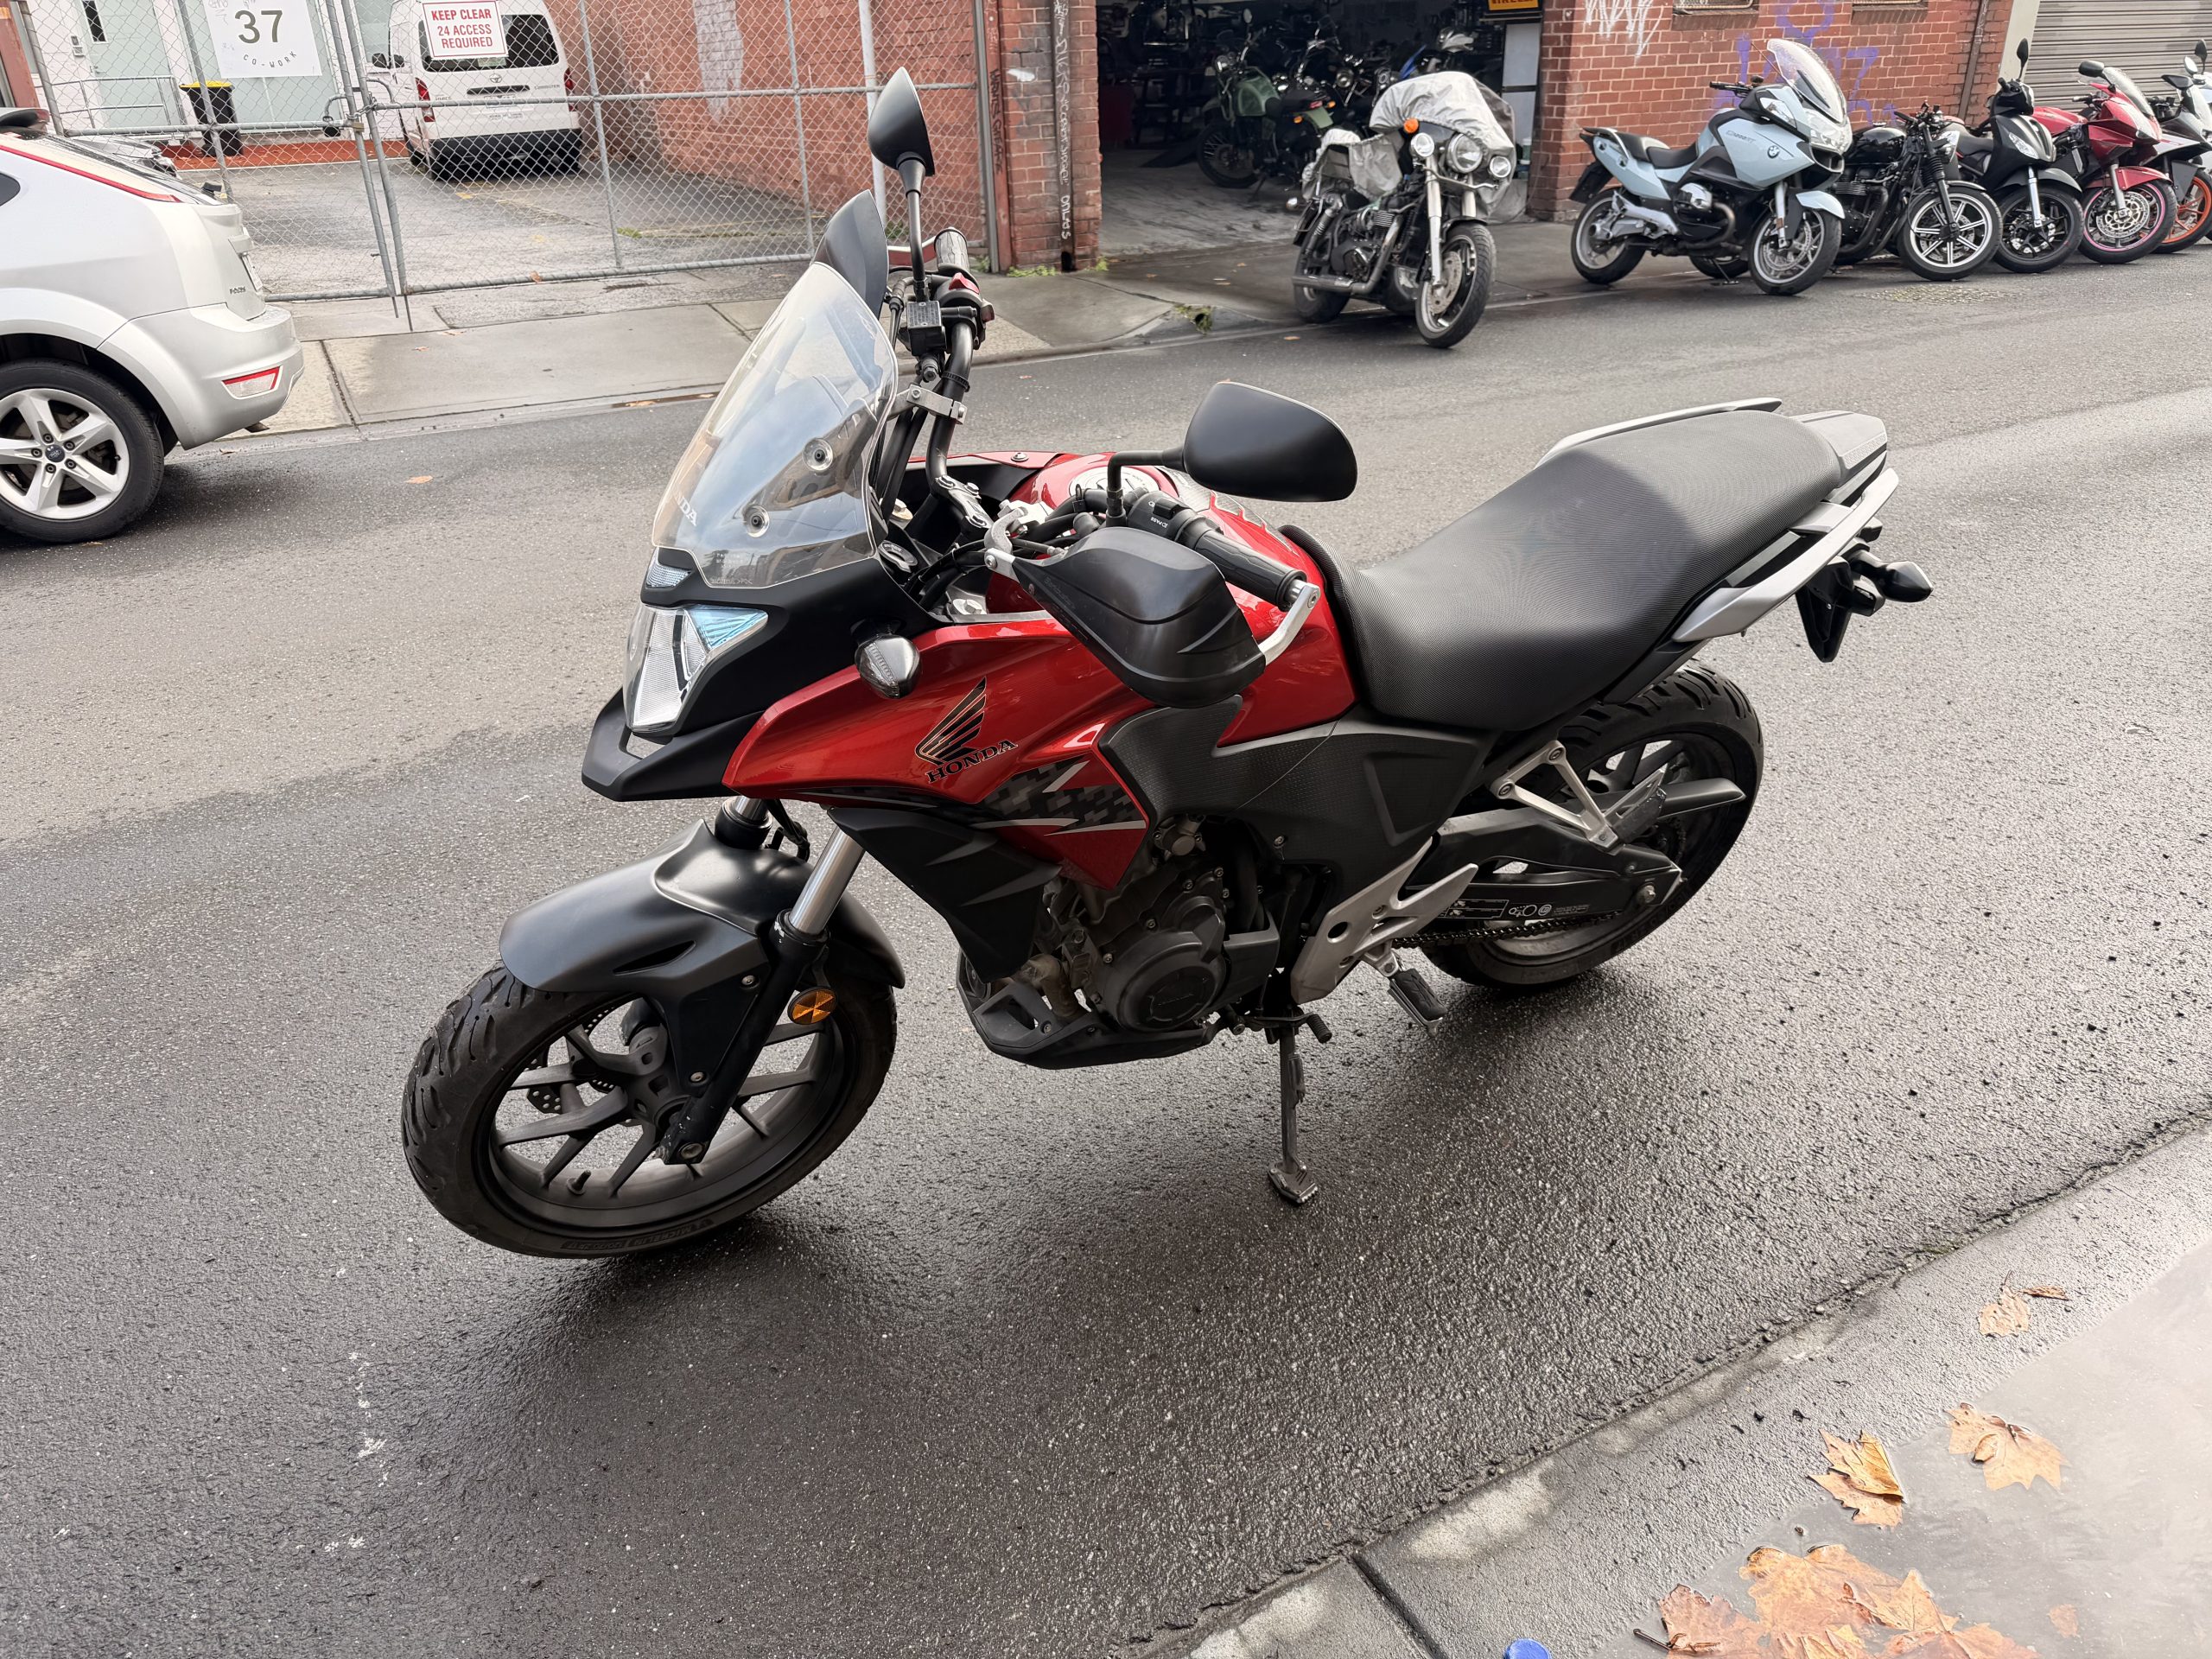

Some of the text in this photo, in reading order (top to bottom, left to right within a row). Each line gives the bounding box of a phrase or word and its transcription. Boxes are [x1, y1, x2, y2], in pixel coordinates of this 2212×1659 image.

[431, 9, 492, 21] KEEP CLEAR
[234, 10, 283, 43] 37
[437, 24, 492, 36] 24 ACCESS
[442, 36, 493, 48] REQUIRED
[243, 51, 296, 67] CO-WORK
[925, 740, 1019, 784] HONDA
